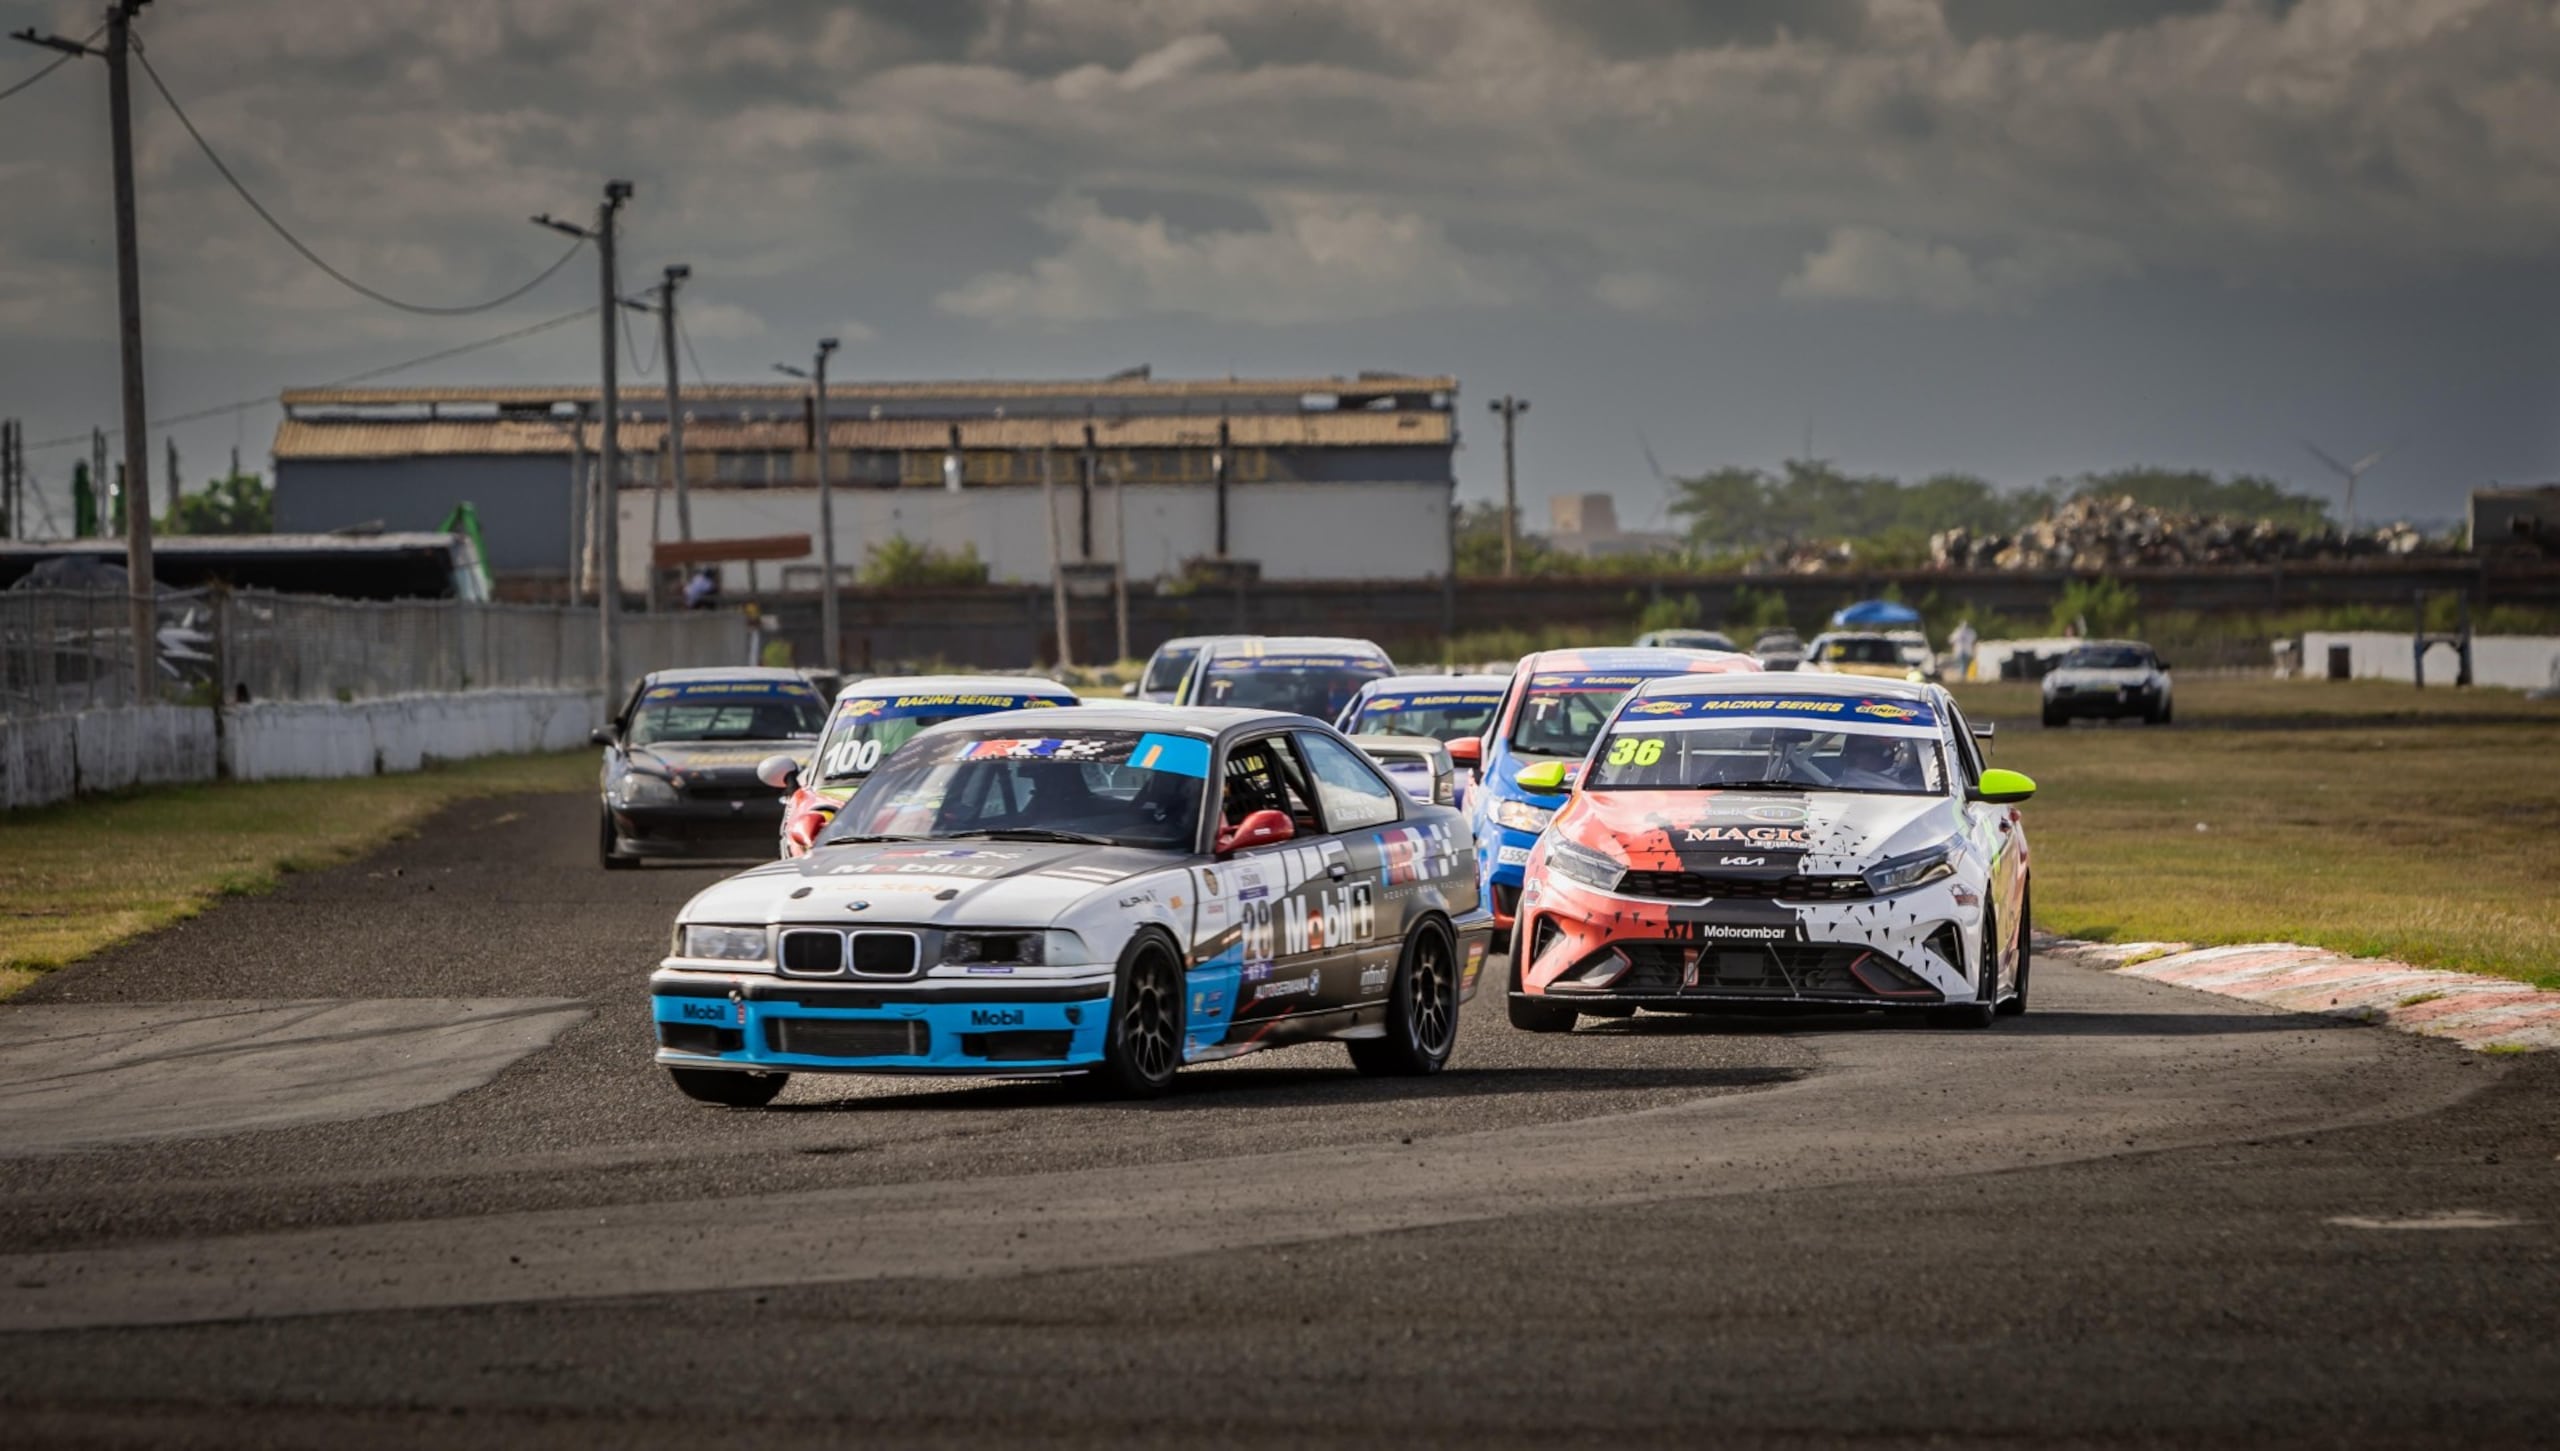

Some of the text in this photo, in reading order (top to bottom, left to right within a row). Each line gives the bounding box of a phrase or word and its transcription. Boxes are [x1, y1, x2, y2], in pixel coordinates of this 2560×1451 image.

[895, 695, 956, 707] RACING
[956, 695, 1013, 707] SERIES
[1701, 701, 1844, 711] RACING SERIES
[824, 739, 881, 774] 100
[1608, 738, 1664, 766] 36
[1685, 827, 1815, 842] MAGIC
[829, 863, 955, 874] Mobil
[1283, 887, 1352, 955] Mobil
[1704, 925, 1786, 939] Motorambar
[683, 1003, 725, 1020] Mobil
[971, 1010, 1024, 1026] Mobil
